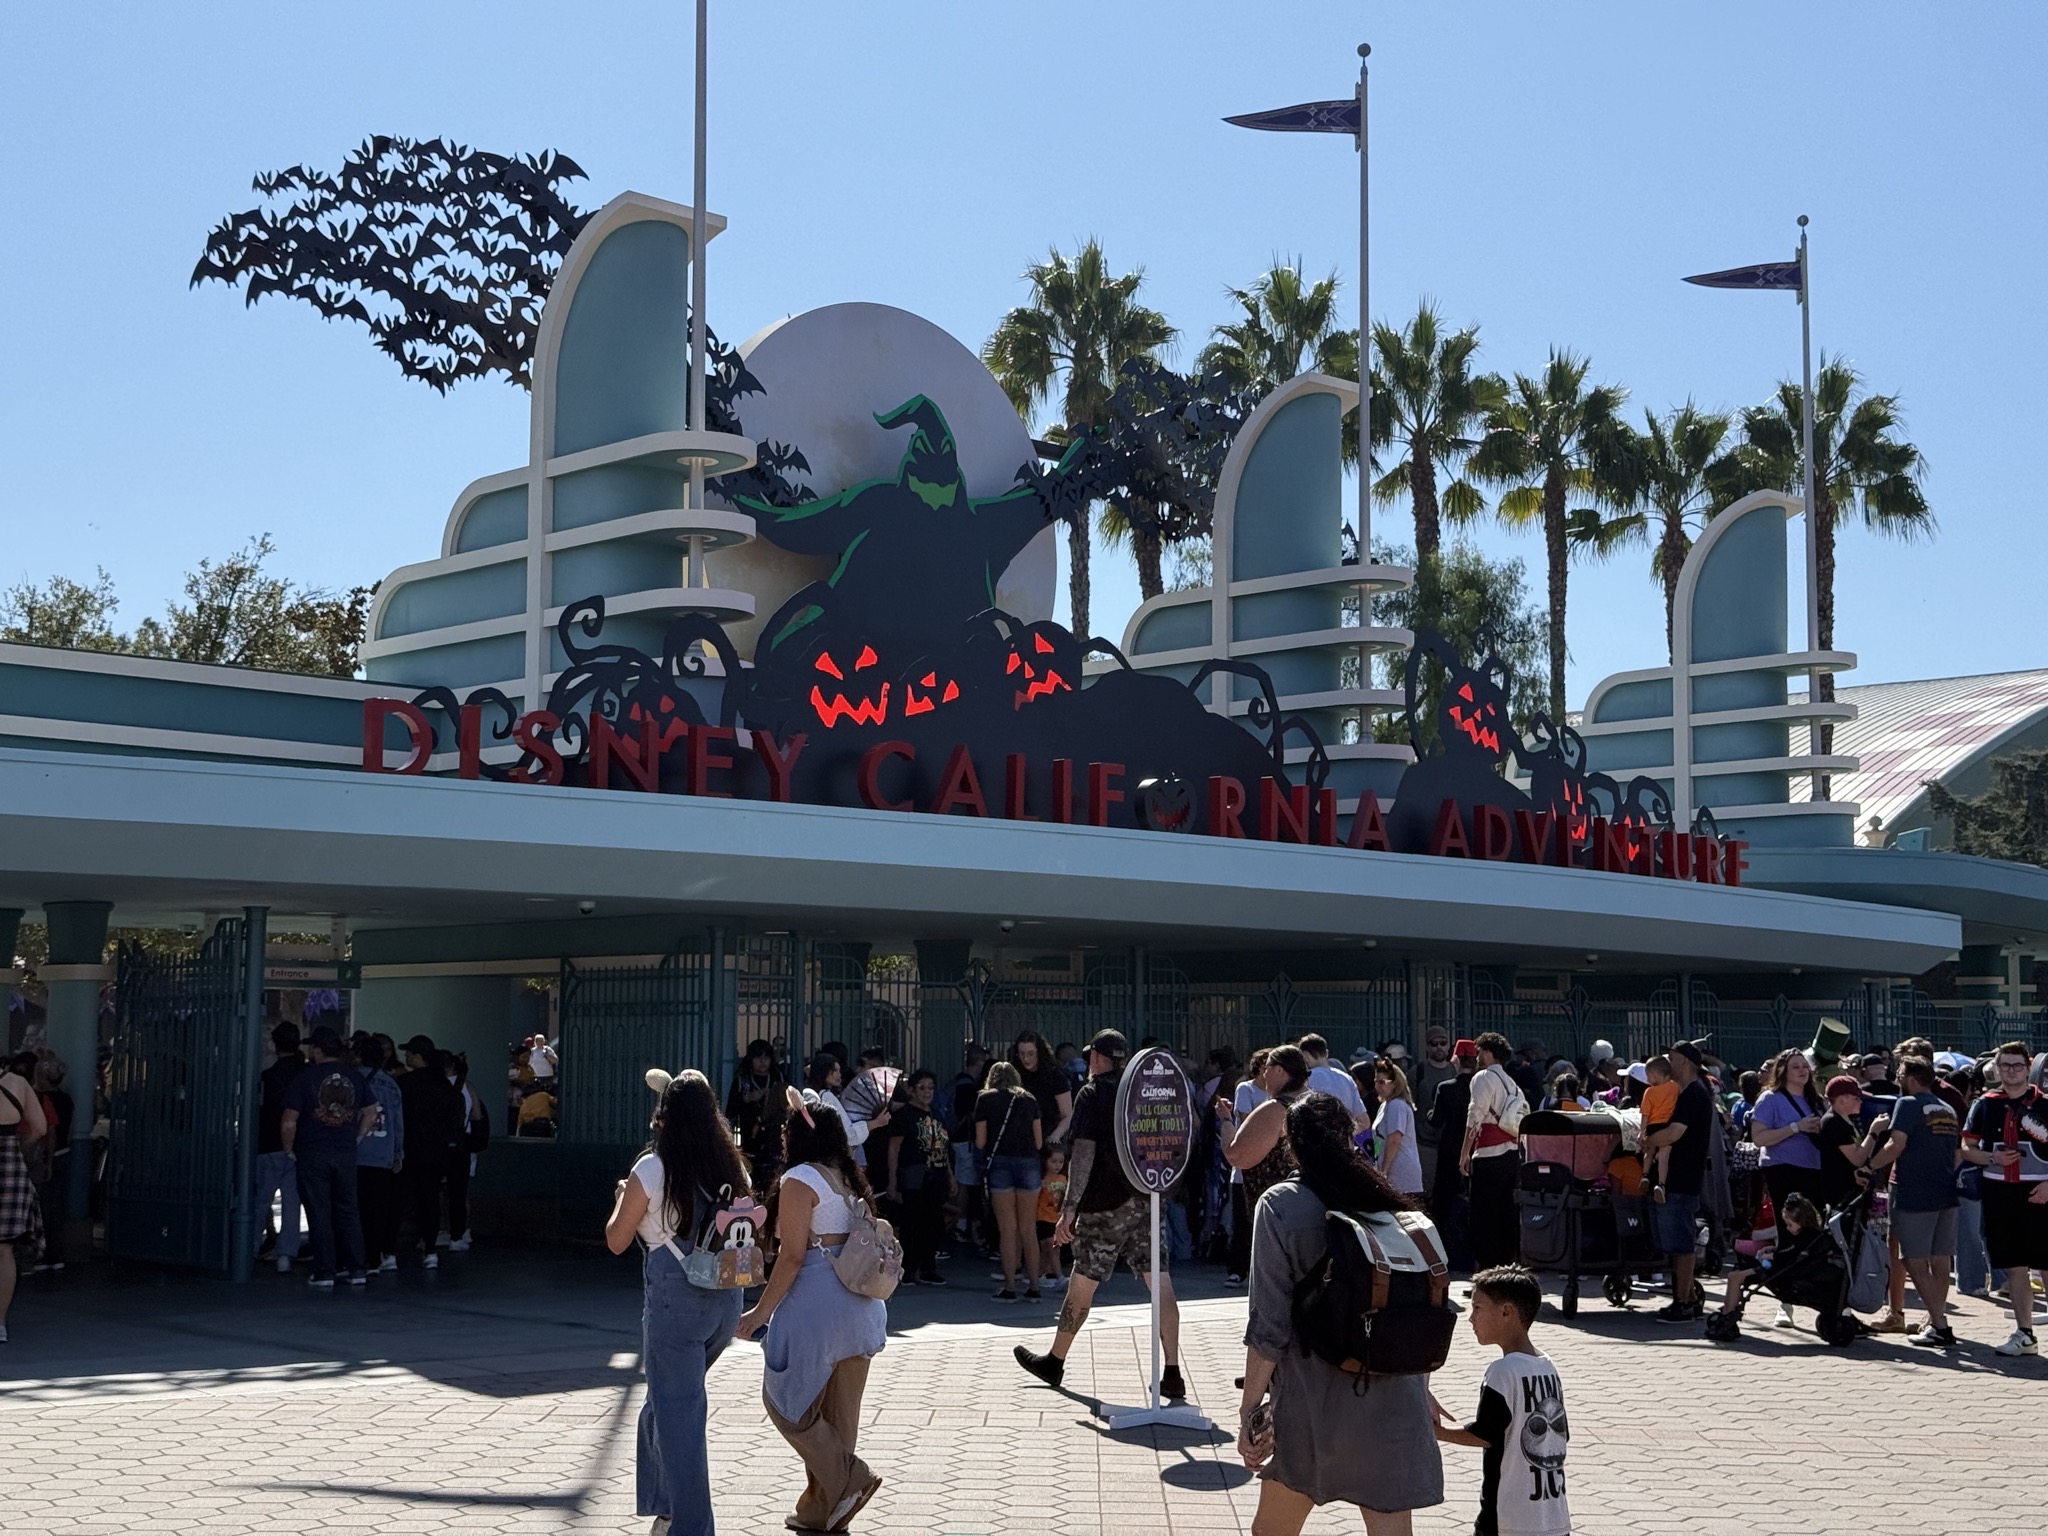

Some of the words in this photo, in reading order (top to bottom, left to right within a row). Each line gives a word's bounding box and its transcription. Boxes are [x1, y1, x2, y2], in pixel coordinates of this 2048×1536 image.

[362, 696, 808, 802] DISNEY
[856, 740, 1393, 853] CALIFORNIA
[1431, 798, 1749, 887] ADVENTURE
[271, 969, 309, 978] Entrance
[1141, 1087, 1176, 1098] CALIFORNIA
[1136, 1104, 1153, 1116] WILL
[1153, 1104, 1172, 1115] CLOSE
[1174, 1104, 1182, 1115] AT
[1164, 1136, 1183, 1146] EVENT
[1161, 1151, 1172, 1160] OUT
